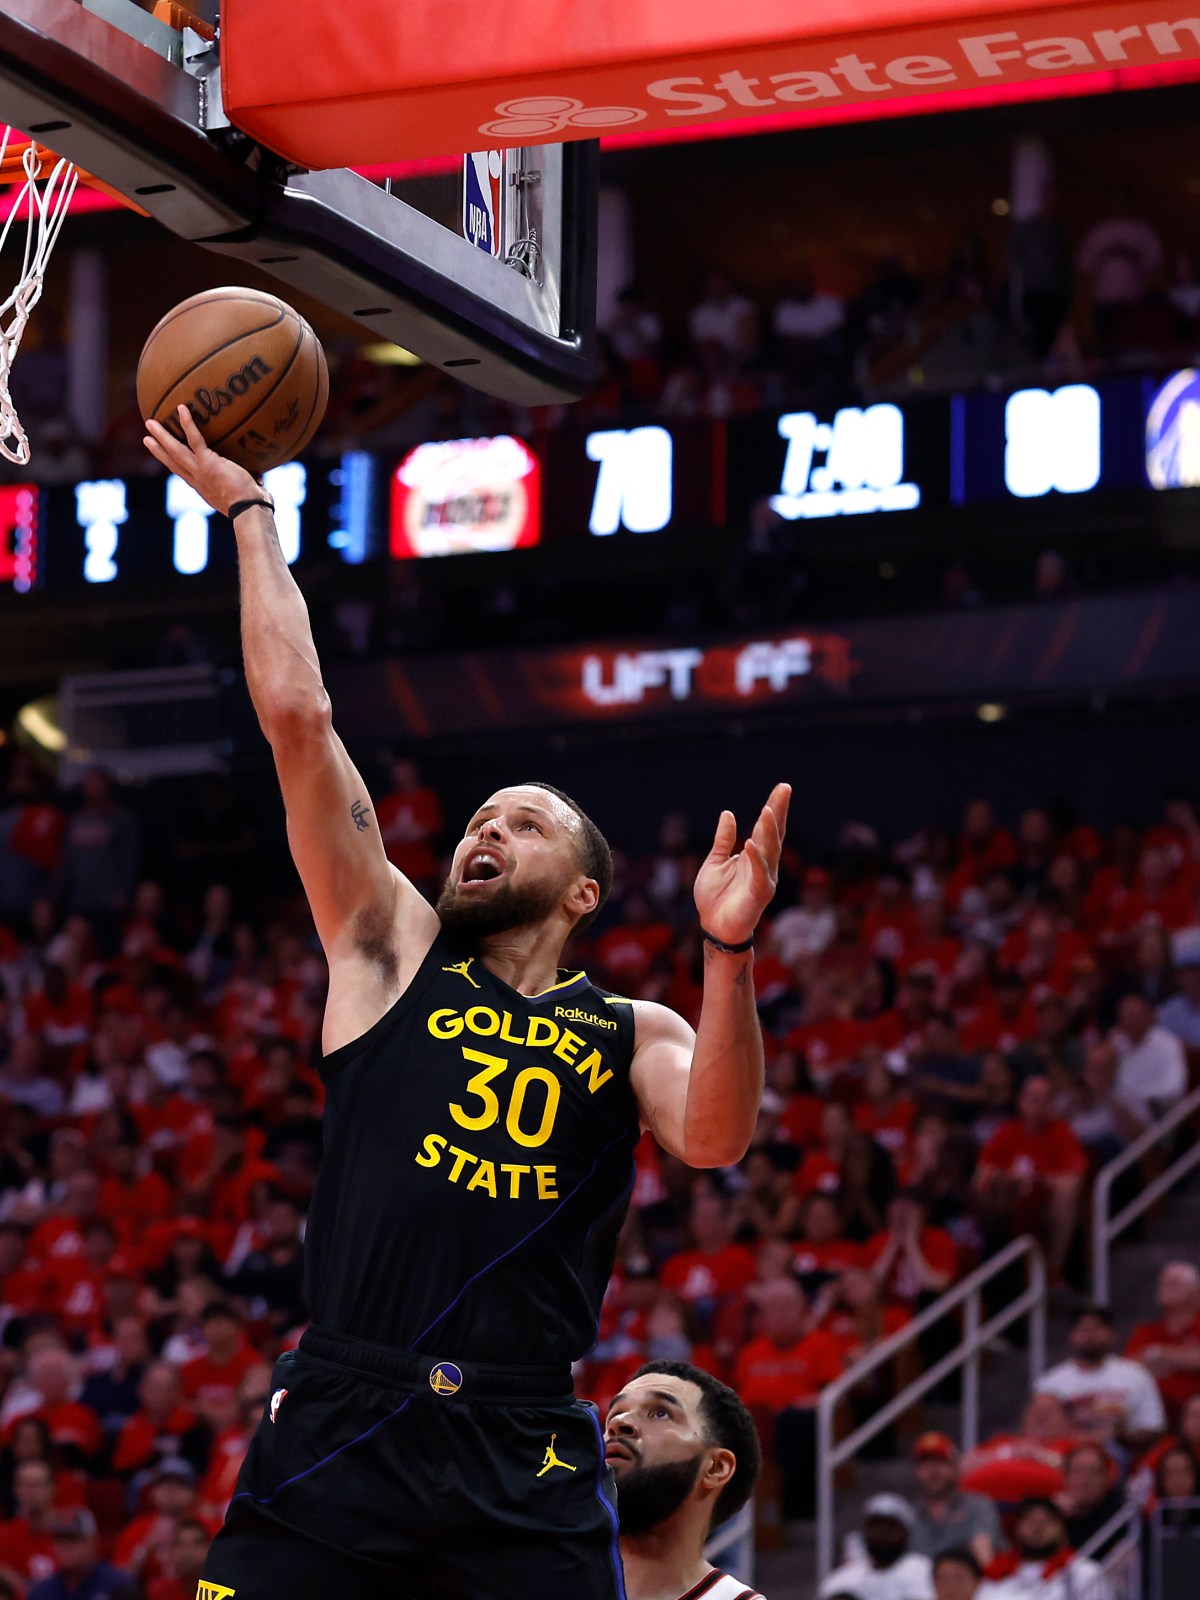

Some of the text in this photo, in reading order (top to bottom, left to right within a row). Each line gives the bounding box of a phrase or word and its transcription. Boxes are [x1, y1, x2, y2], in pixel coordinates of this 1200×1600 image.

[647, 48, 958, 117] State
[469, 202, 487, 242] NBA
[427, 1005, 614, 1094] GOLDEN
[554, 1006, 618, 1031] Rakuten
[448, 1046, 561, 1148] 30
[414, 1133, 559, 1200] STATE
